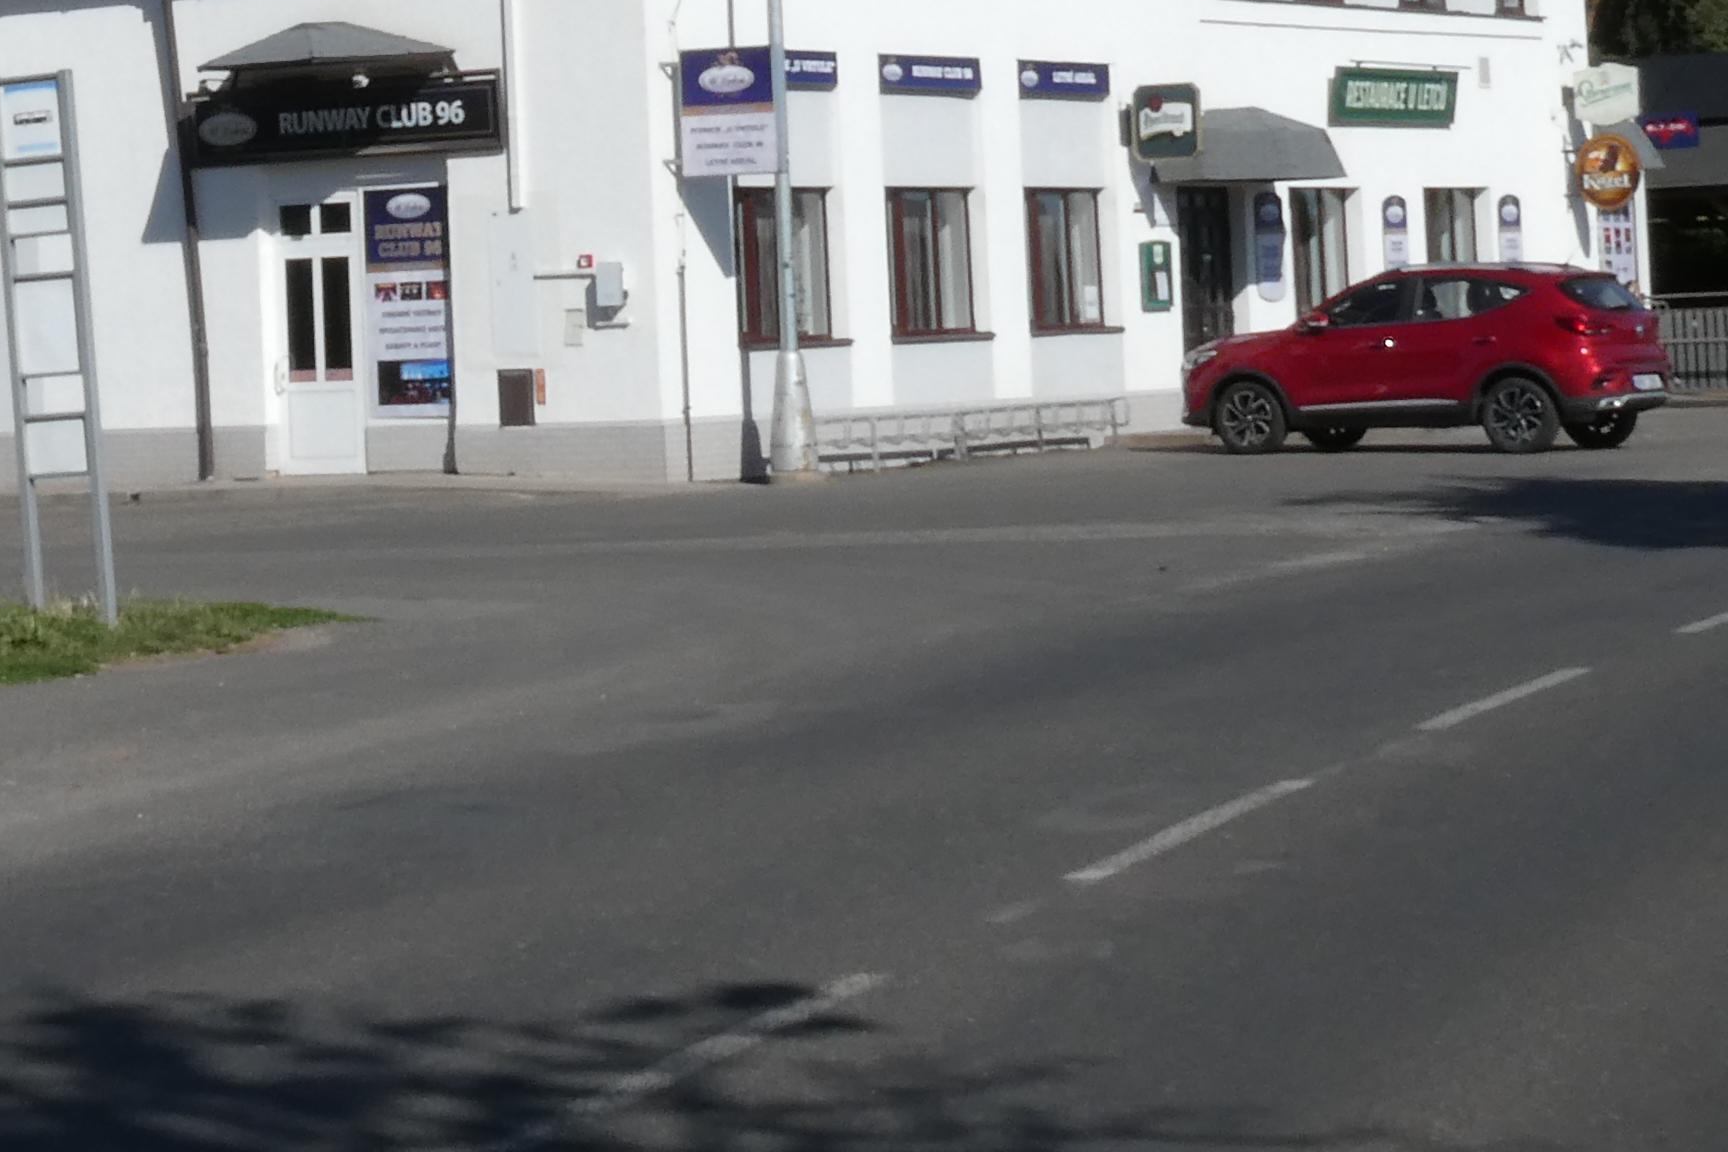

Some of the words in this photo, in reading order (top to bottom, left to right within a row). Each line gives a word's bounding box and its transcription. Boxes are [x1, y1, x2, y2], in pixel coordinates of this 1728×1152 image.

[1345, 80, 1408, 110] RESTAURACE
[278, 106, 370, 136] RUNWAY
[376, 102, 433, 129] CLUB
[436, 100, 466, 125] 96
